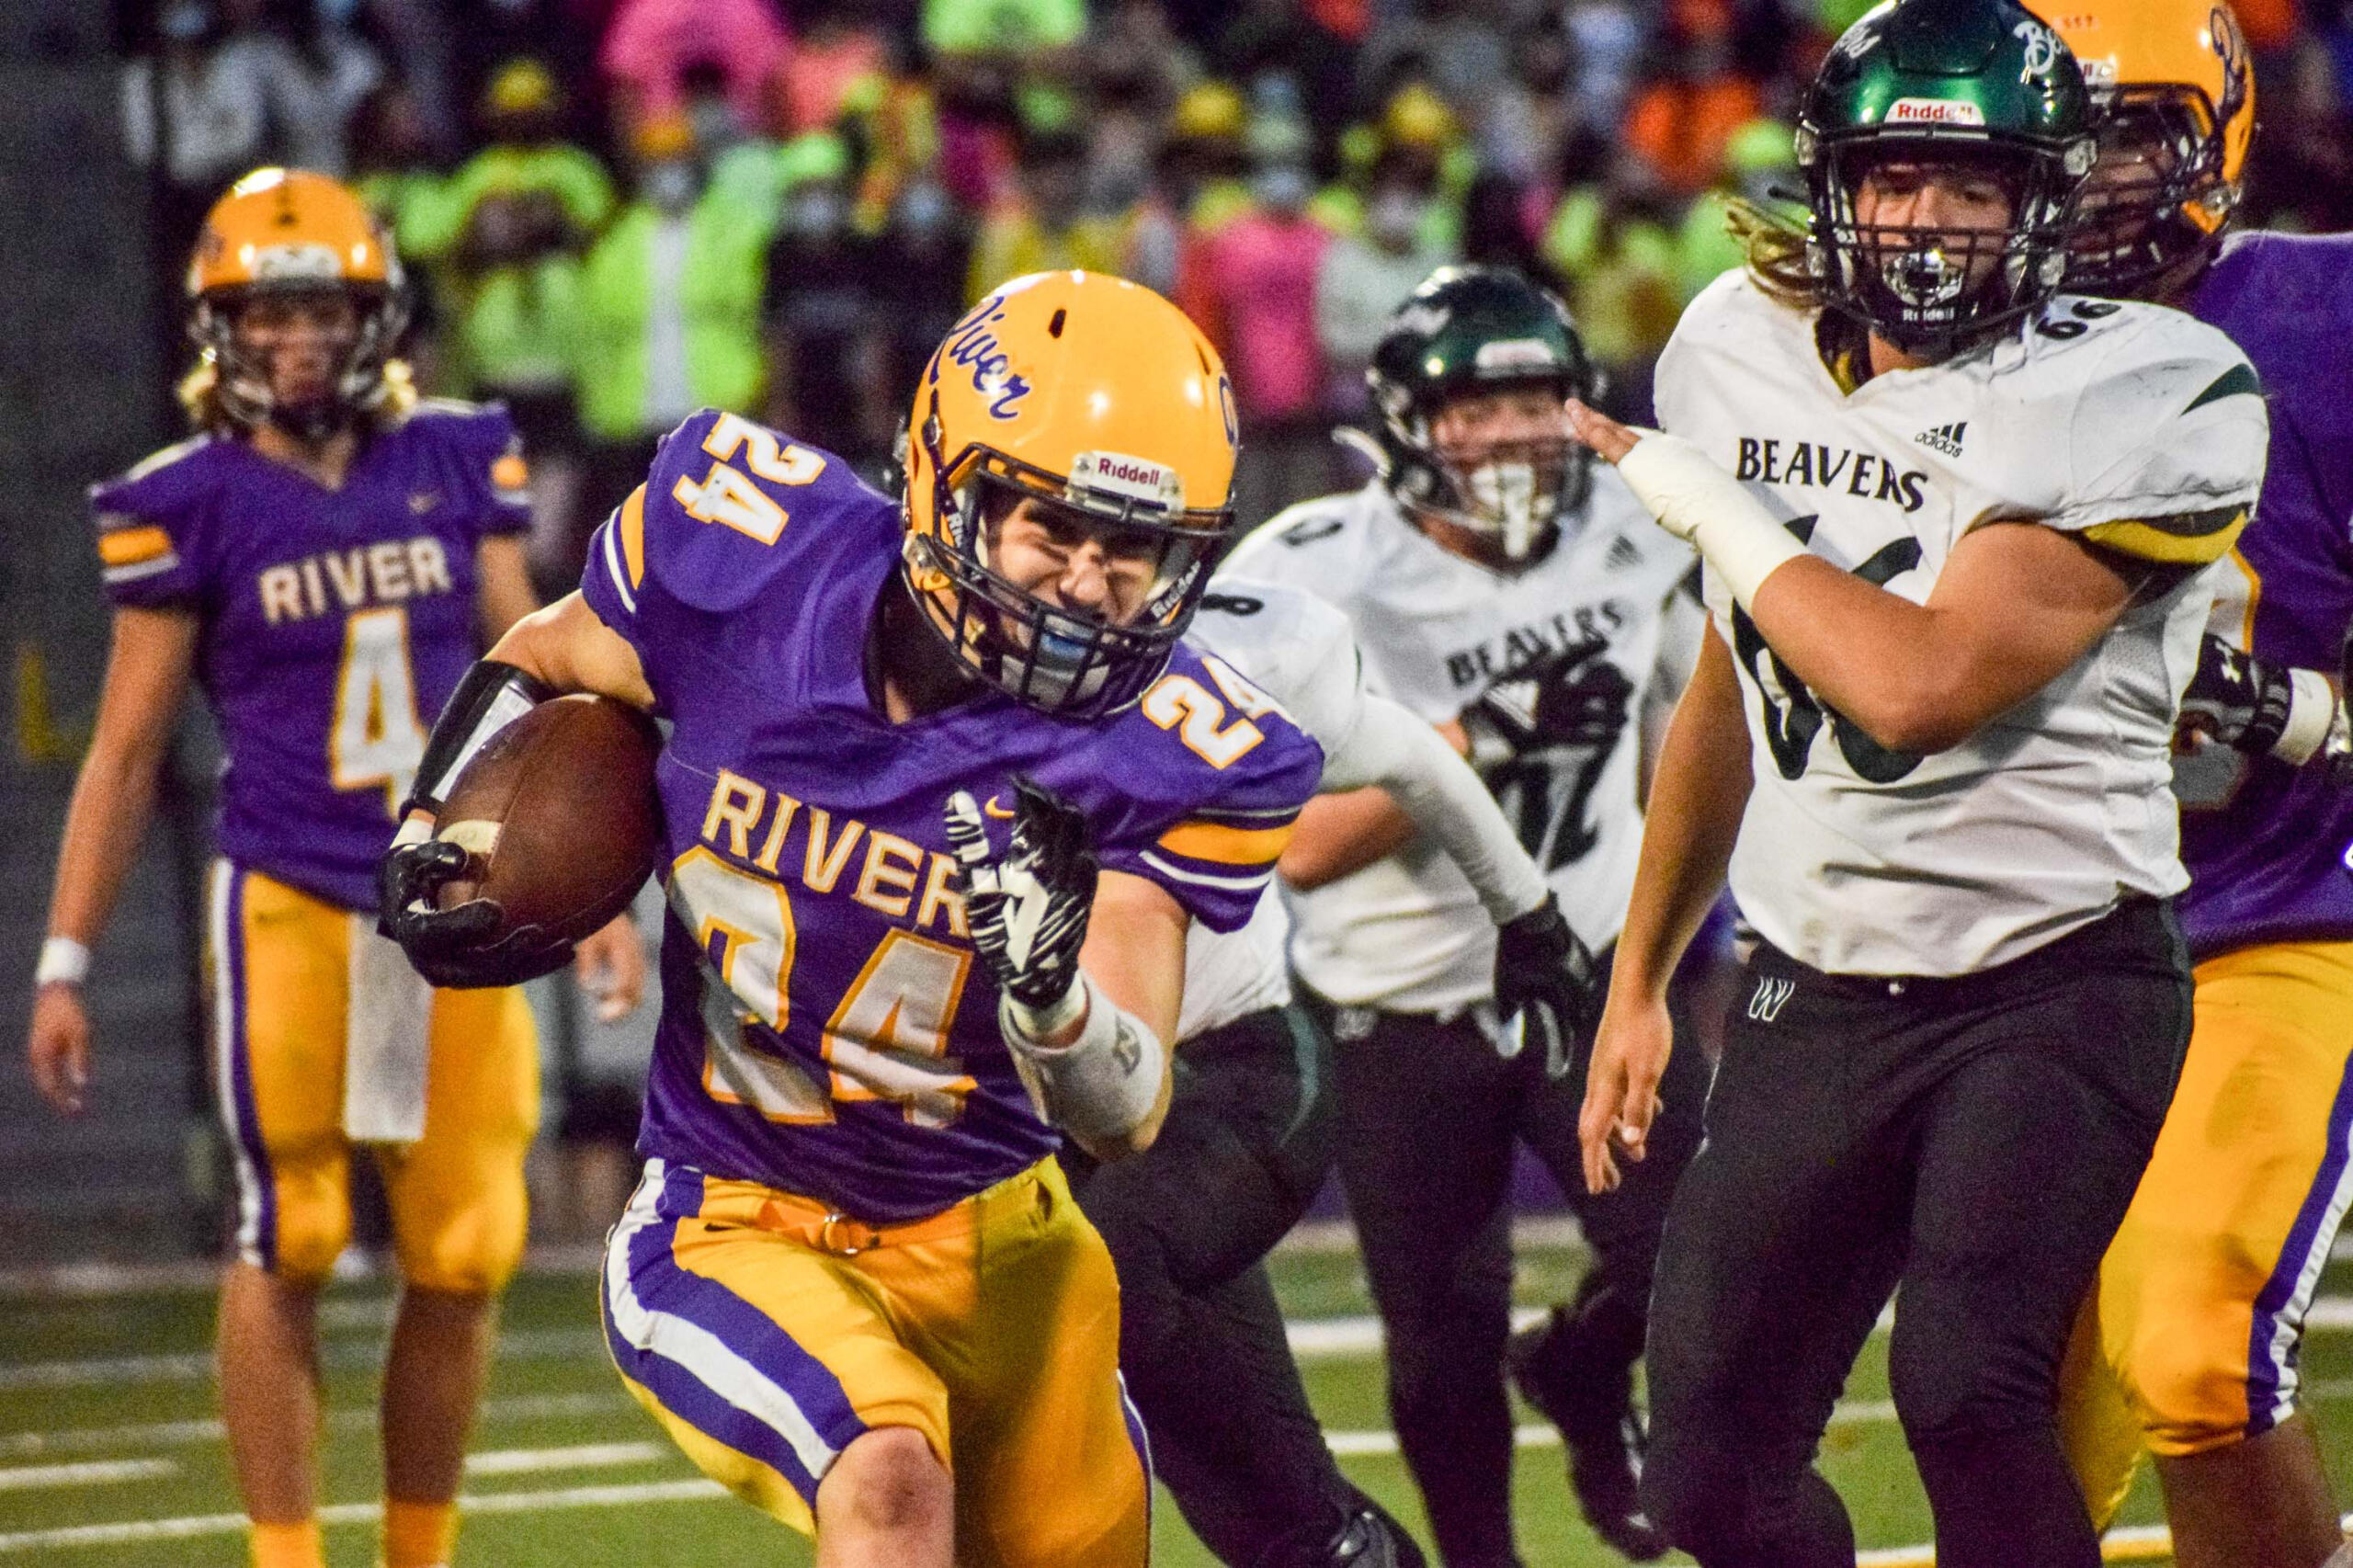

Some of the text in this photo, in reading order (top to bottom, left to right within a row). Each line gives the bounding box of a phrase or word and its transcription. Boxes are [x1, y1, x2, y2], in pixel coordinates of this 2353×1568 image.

[2035, 300, 2122, 341] 66
[672, 411, 827, 546] 24
[1098, 457, 1160, 485] Riddell
[1735, 437, 1928, 513] BEAVERS
[1914, 427, 1963, 458] adidas
[258, 536, 452, 625] RIVER
[1446, 598, 1623, 687] BEAVERS
[328, 606, 432, 823] 4
[700, 767, 972, 940] RIVER
[666, 844, 980, 1129] 24
[1748, 975, 1796, 1022] W
